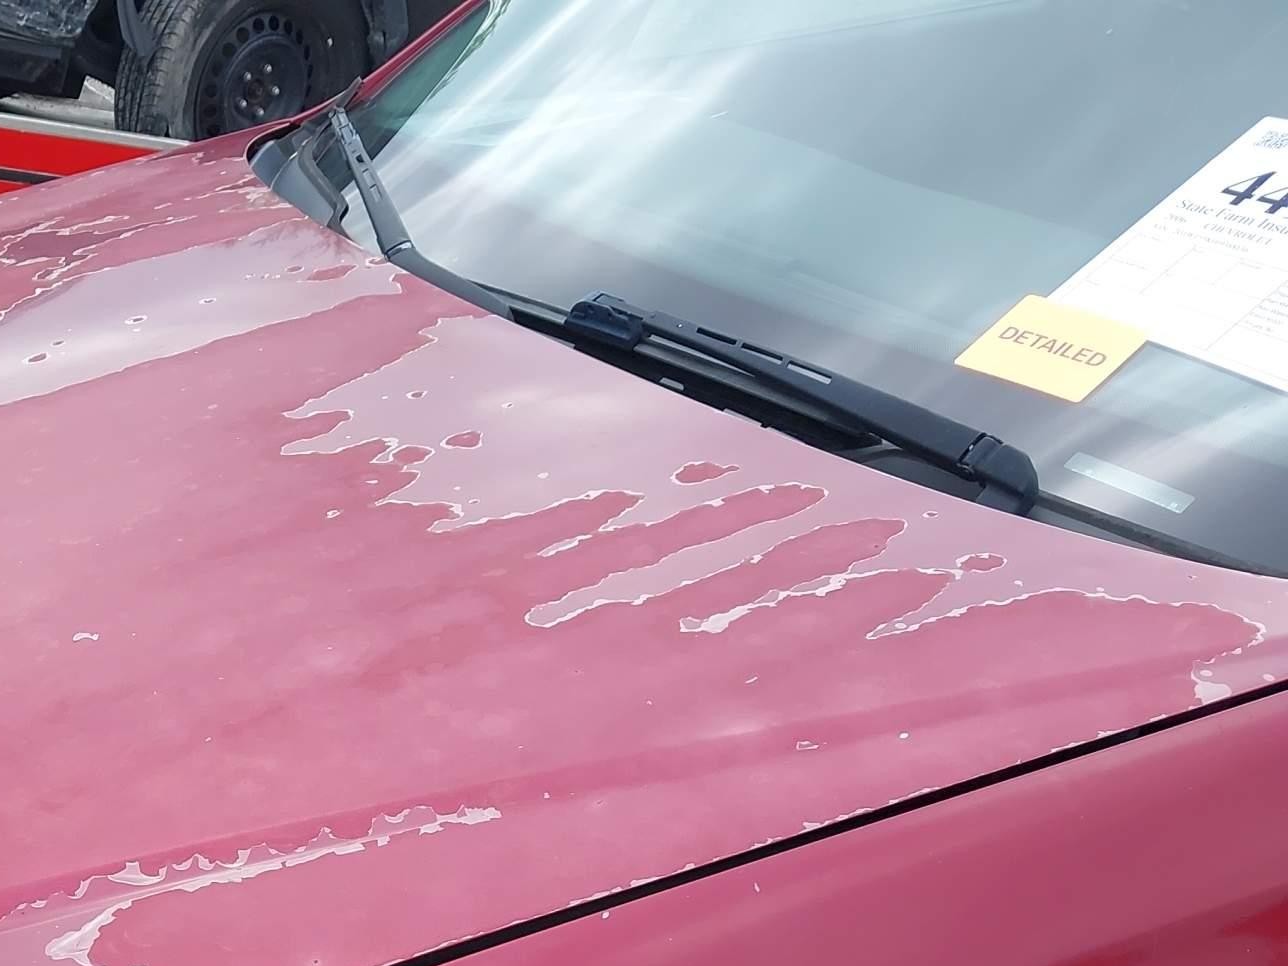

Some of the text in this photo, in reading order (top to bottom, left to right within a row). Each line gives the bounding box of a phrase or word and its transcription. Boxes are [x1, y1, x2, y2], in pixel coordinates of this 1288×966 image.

[1176, 199, 1214, 215] State
[1215, 207, 1255, 226] Farm
[998, 326, 1107, 367] DETAILED
